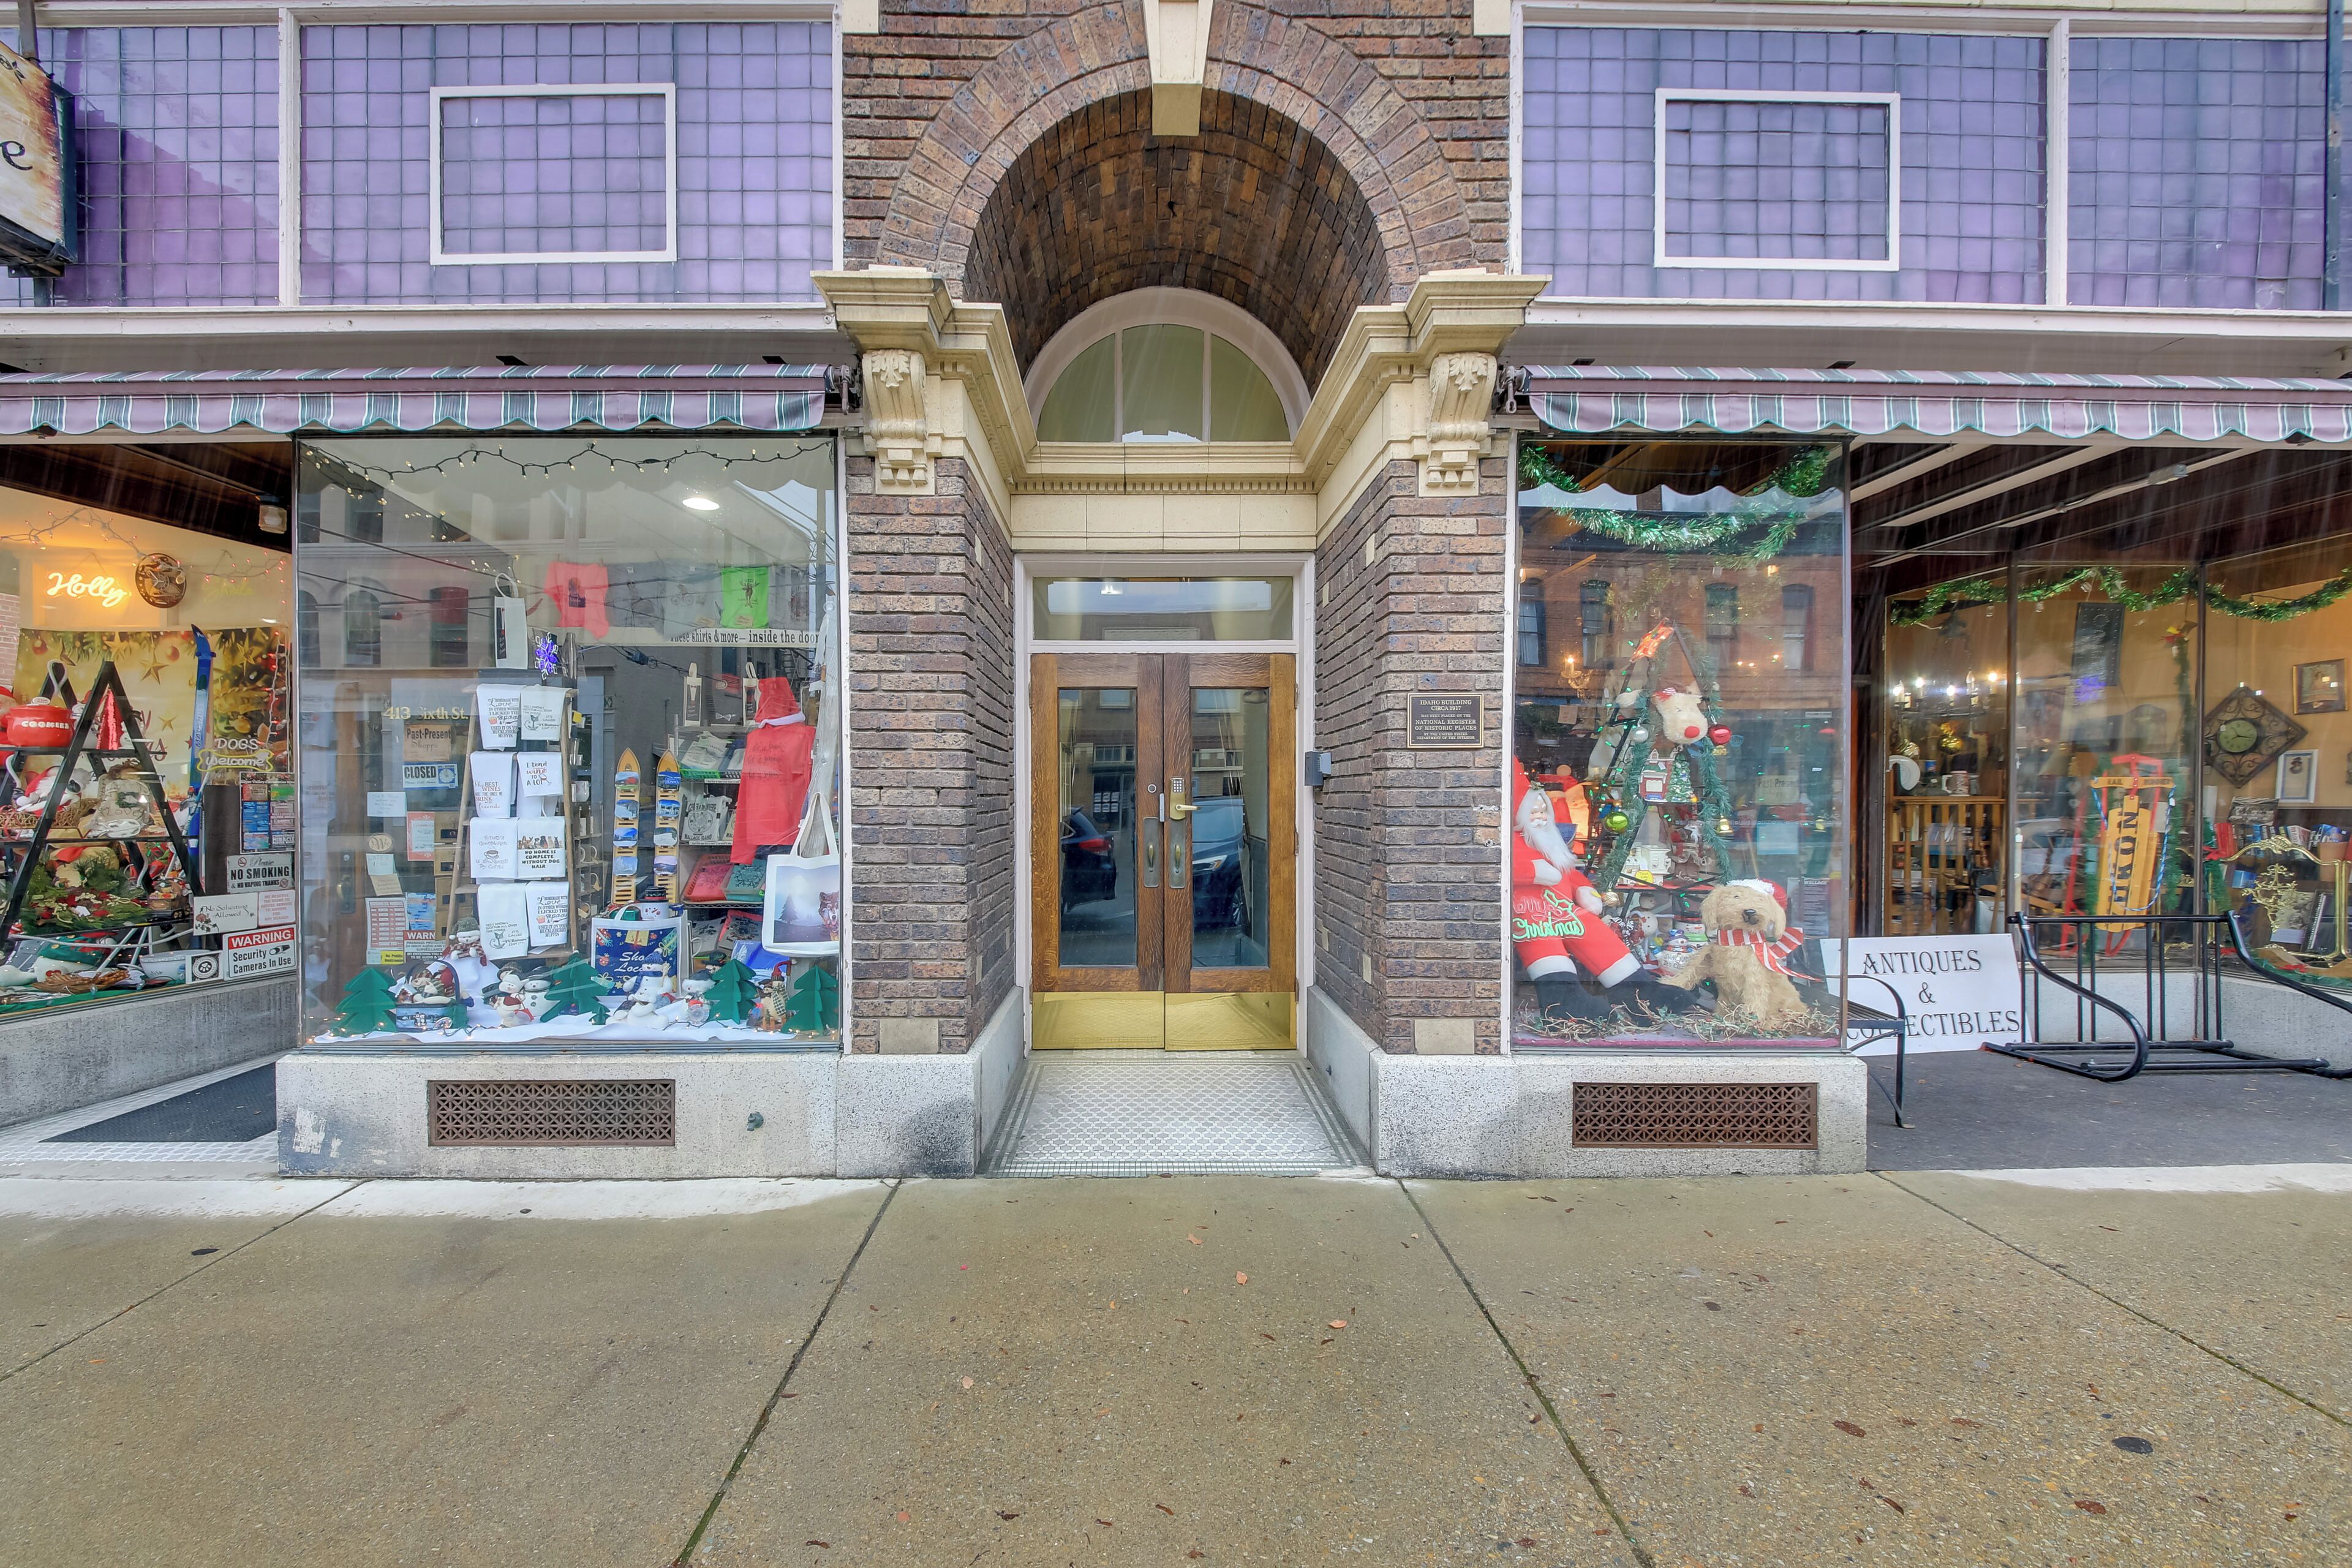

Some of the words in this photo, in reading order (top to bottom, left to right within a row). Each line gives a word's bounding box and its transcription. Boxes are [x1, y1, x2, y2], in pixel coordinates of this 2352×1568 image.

[47, 572, 127, 608] Holly
[692, 630, 712, 643] shirts
[714, 630, 720, 643] &
[749, 630, 777, 643] inside
[780, 630, 795, 643] the
[799, 631, 819, 643] door
[382, 706, 411, 720] 413
[417, 706, 449, 721] Sixth
[451, 707, 469, 720] St.
[407, 728, 451, 739] Past-Present
[205, 756, 265, 766] Welcome
[404, 766, 437, 779] CLOSED
[106, 808, 139, 817] LOVE
[249, 856, 274, 867] Please
[231, 869, 243, 880] NO
[246, 866, 289, 879] SMOKING
[1513, 911, 1585, 939] Christmas
[231, 930, 291, 948] WARNING
[233, 949, 266, 962] Security
[1862, 950, 1981, 975] ANTIQUES
[233, 962, 267, 974] Cameras
[269, 959, 276, 968] In
[278, 957, 292, 966] Use
[1918, 982, 1936, 1003] &
